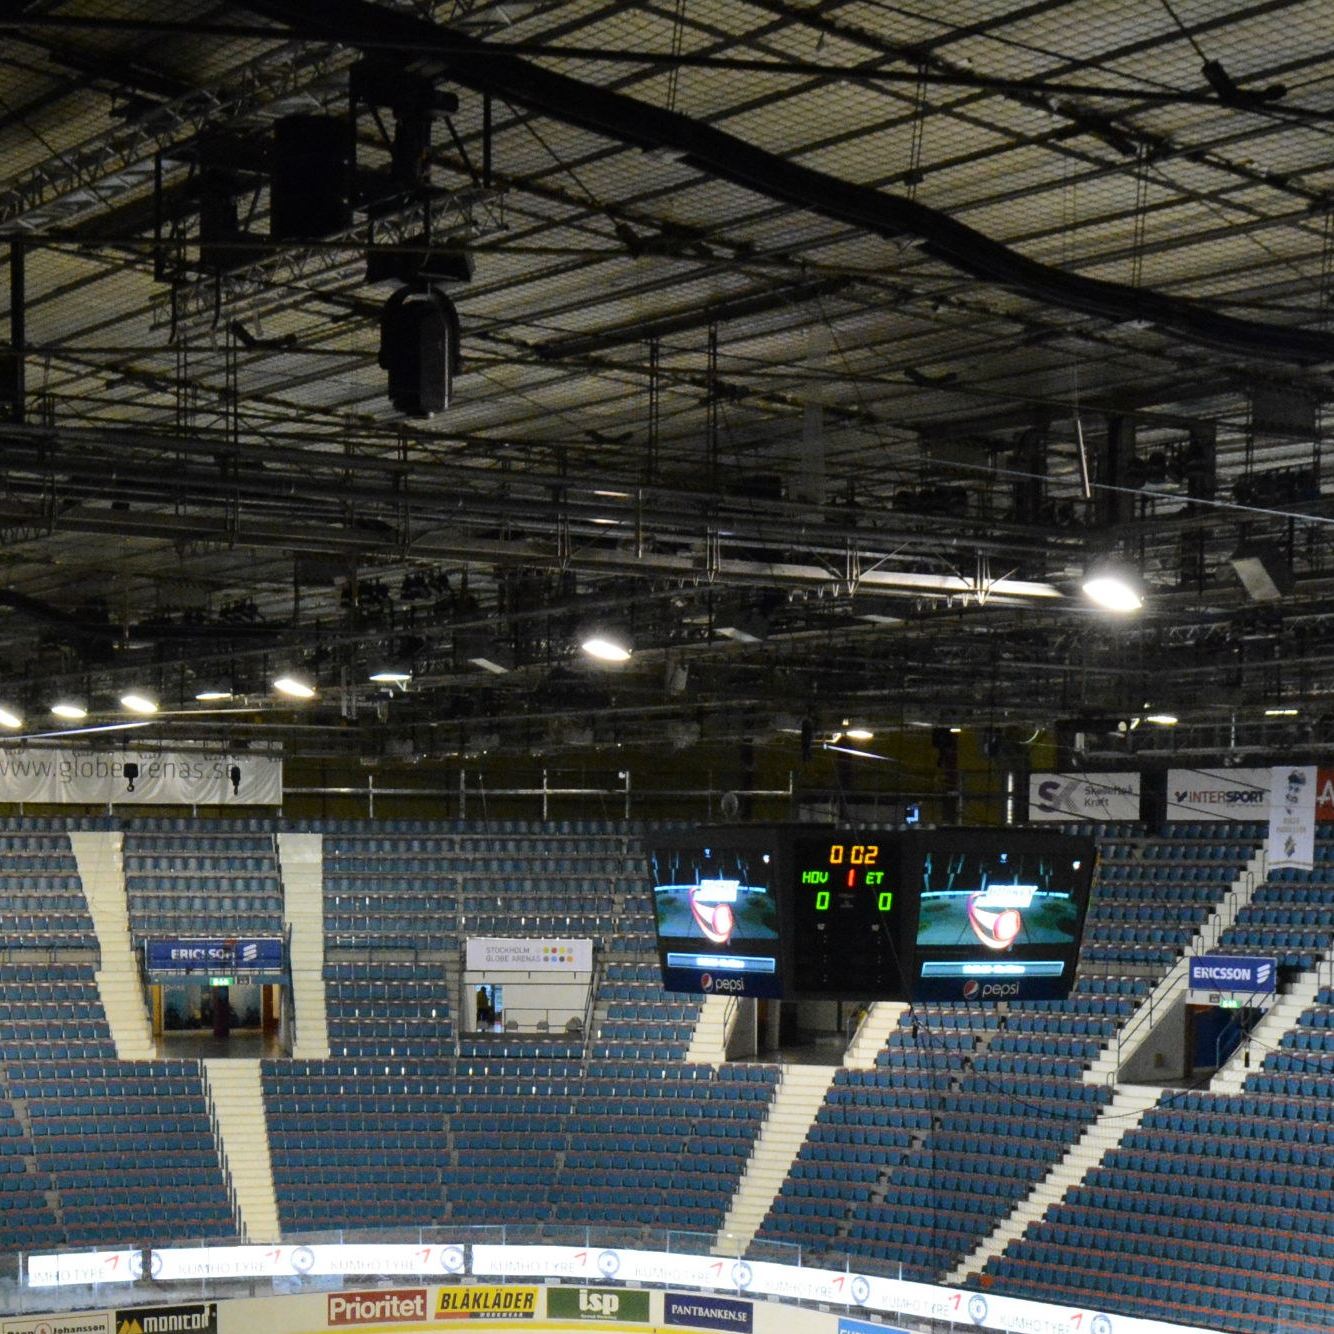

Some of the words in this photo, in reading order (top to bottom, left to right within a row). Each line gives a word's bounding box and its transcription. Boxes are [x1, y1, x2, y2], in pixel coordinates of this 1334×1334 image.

[1190, 791, 1265, 804] INTERSPORT
[847, 868, 856, 888] 1
[865, 871, 884, 885] ET
[815, 891, 830, 911] 0
[878, 892, 892, 911] 0
[1193, 967, 1251, 981] ERICSSON
[715, 976, 745, 993] pepsi
[982, 981, 1020, 997] pepsi
[178, 1263, 230, 1276] KUMHO
[234, 1262, 266, 1273] TYRE
[330, 1260, 378, 1270] KUMHO
[383, 1260, 415, 1270] TYRE
[490, 1262, 538, 1272] KUMHO
[543, 1262, 575, 1273] TYRE
[440, 1287, 534, 1309] BLÅKLÄDER
[579, 1288, 619, 1315] isp
[330, 1294, 424, 1321] Prioritet
[671, 1304, 748, 1322] PANTBANKEN.SE
[53, 1324, 105, 1334] Johansson
